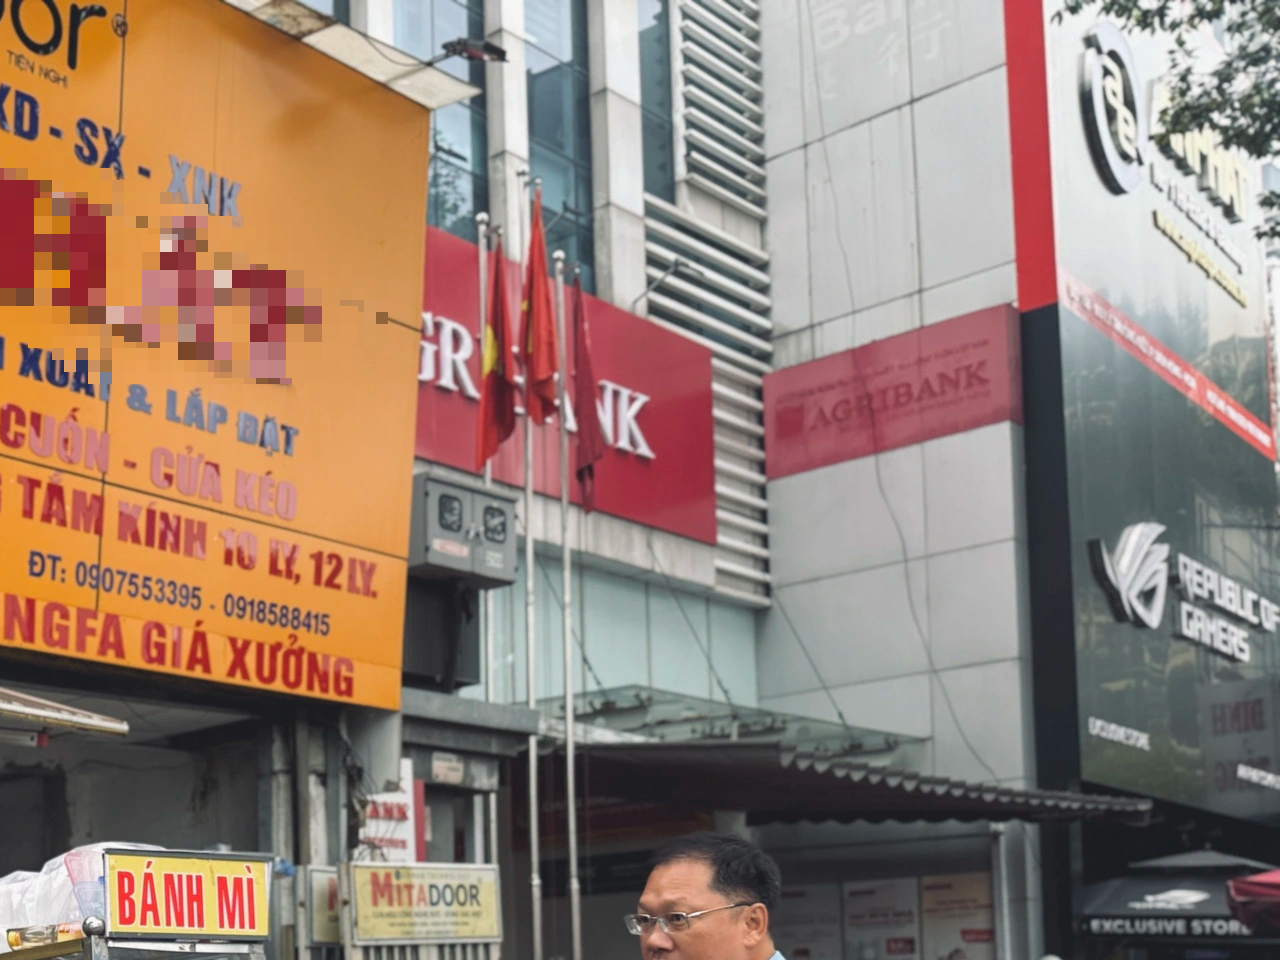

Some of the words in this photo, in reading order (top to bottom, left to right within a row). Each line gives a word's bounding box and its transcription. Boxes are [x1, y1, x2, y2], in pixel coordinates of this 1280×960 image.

[75, 118, 126, 181] SX
[168, 154, 242, 230] XNK
[808, 359, 991, 433] AGRIBANK
[0, 407, 110, 474] CUỐN
[149, 444, 223, 504] CỬA
[234, 470, 298, 522] KÉO
[117, 500, 208, 561] KÍNH
[220, 528, 257, 572] 10
[309, 550, 344, 590] 12
[75, 562, 203, 612] 0907553395
[1177, 552, 1260, 627] REPUBLIC
[140, 619, 212, 675] GIÁ
[226, 634, 356, 698] XƯỞNG
[1180, 602, 1251, 664] GAMERS
[117, 859, 205, 930] BÁNH
[216, 865, 258, 931] MÌ
[1089, 918, 1188, 936] EXCLUSIVE
